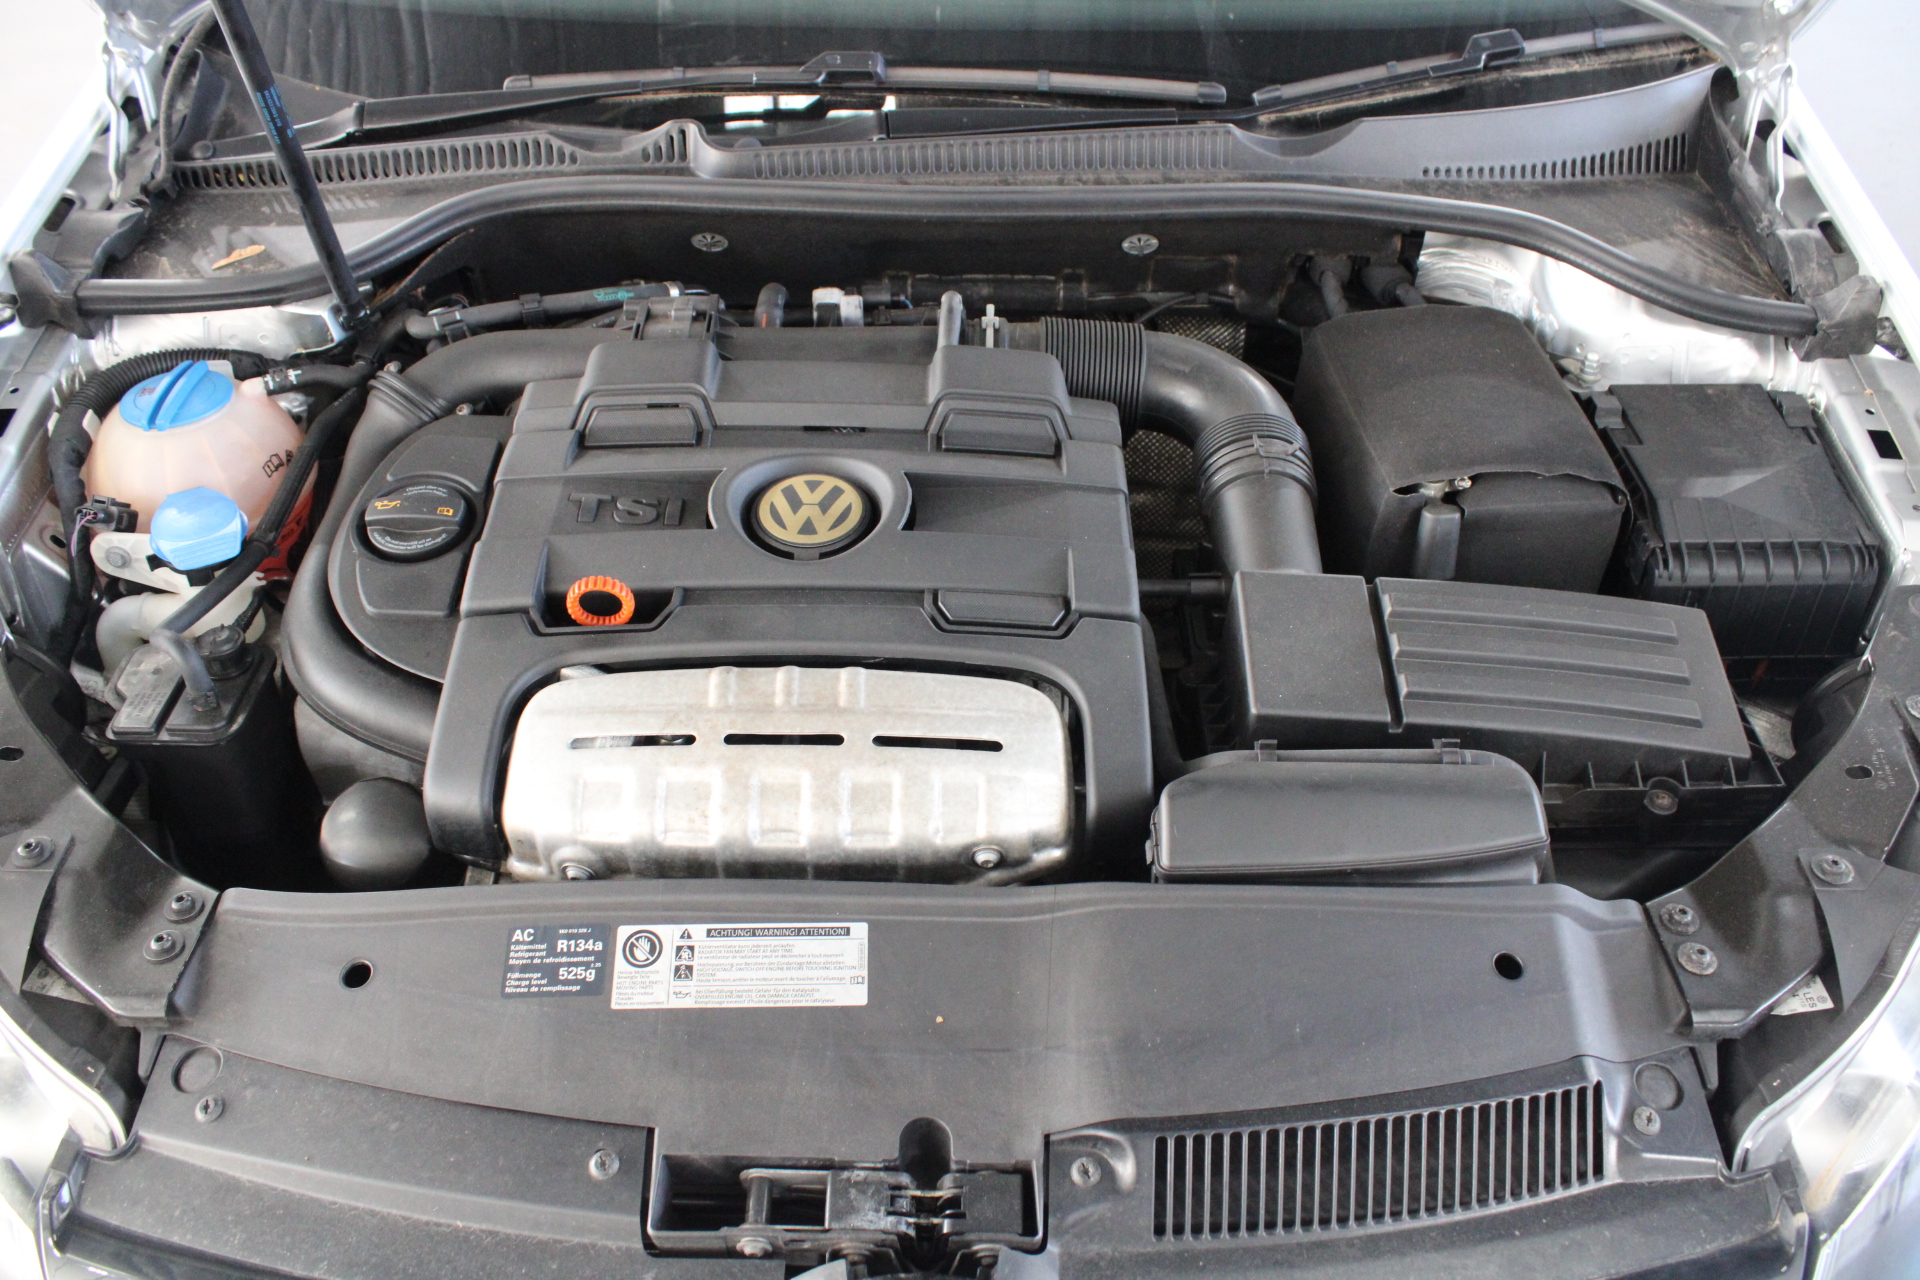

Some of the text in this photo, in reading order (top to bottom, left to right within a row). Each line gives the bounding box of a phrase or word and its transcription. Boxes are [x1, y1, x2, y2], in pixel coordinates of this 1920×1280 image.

[567, 493, 686, 526] TSI
[512, 929, 535, 942] AC
[710, 928, 847, 937] ACHTUNG! WARNING! ATTENTION!
[557, 939, 603, 952] R134a
[543, 956, 595, 964] refroidissement
[507, 972, 541, 980] Füllmenge
[559, 967, 596, 982] 525g
